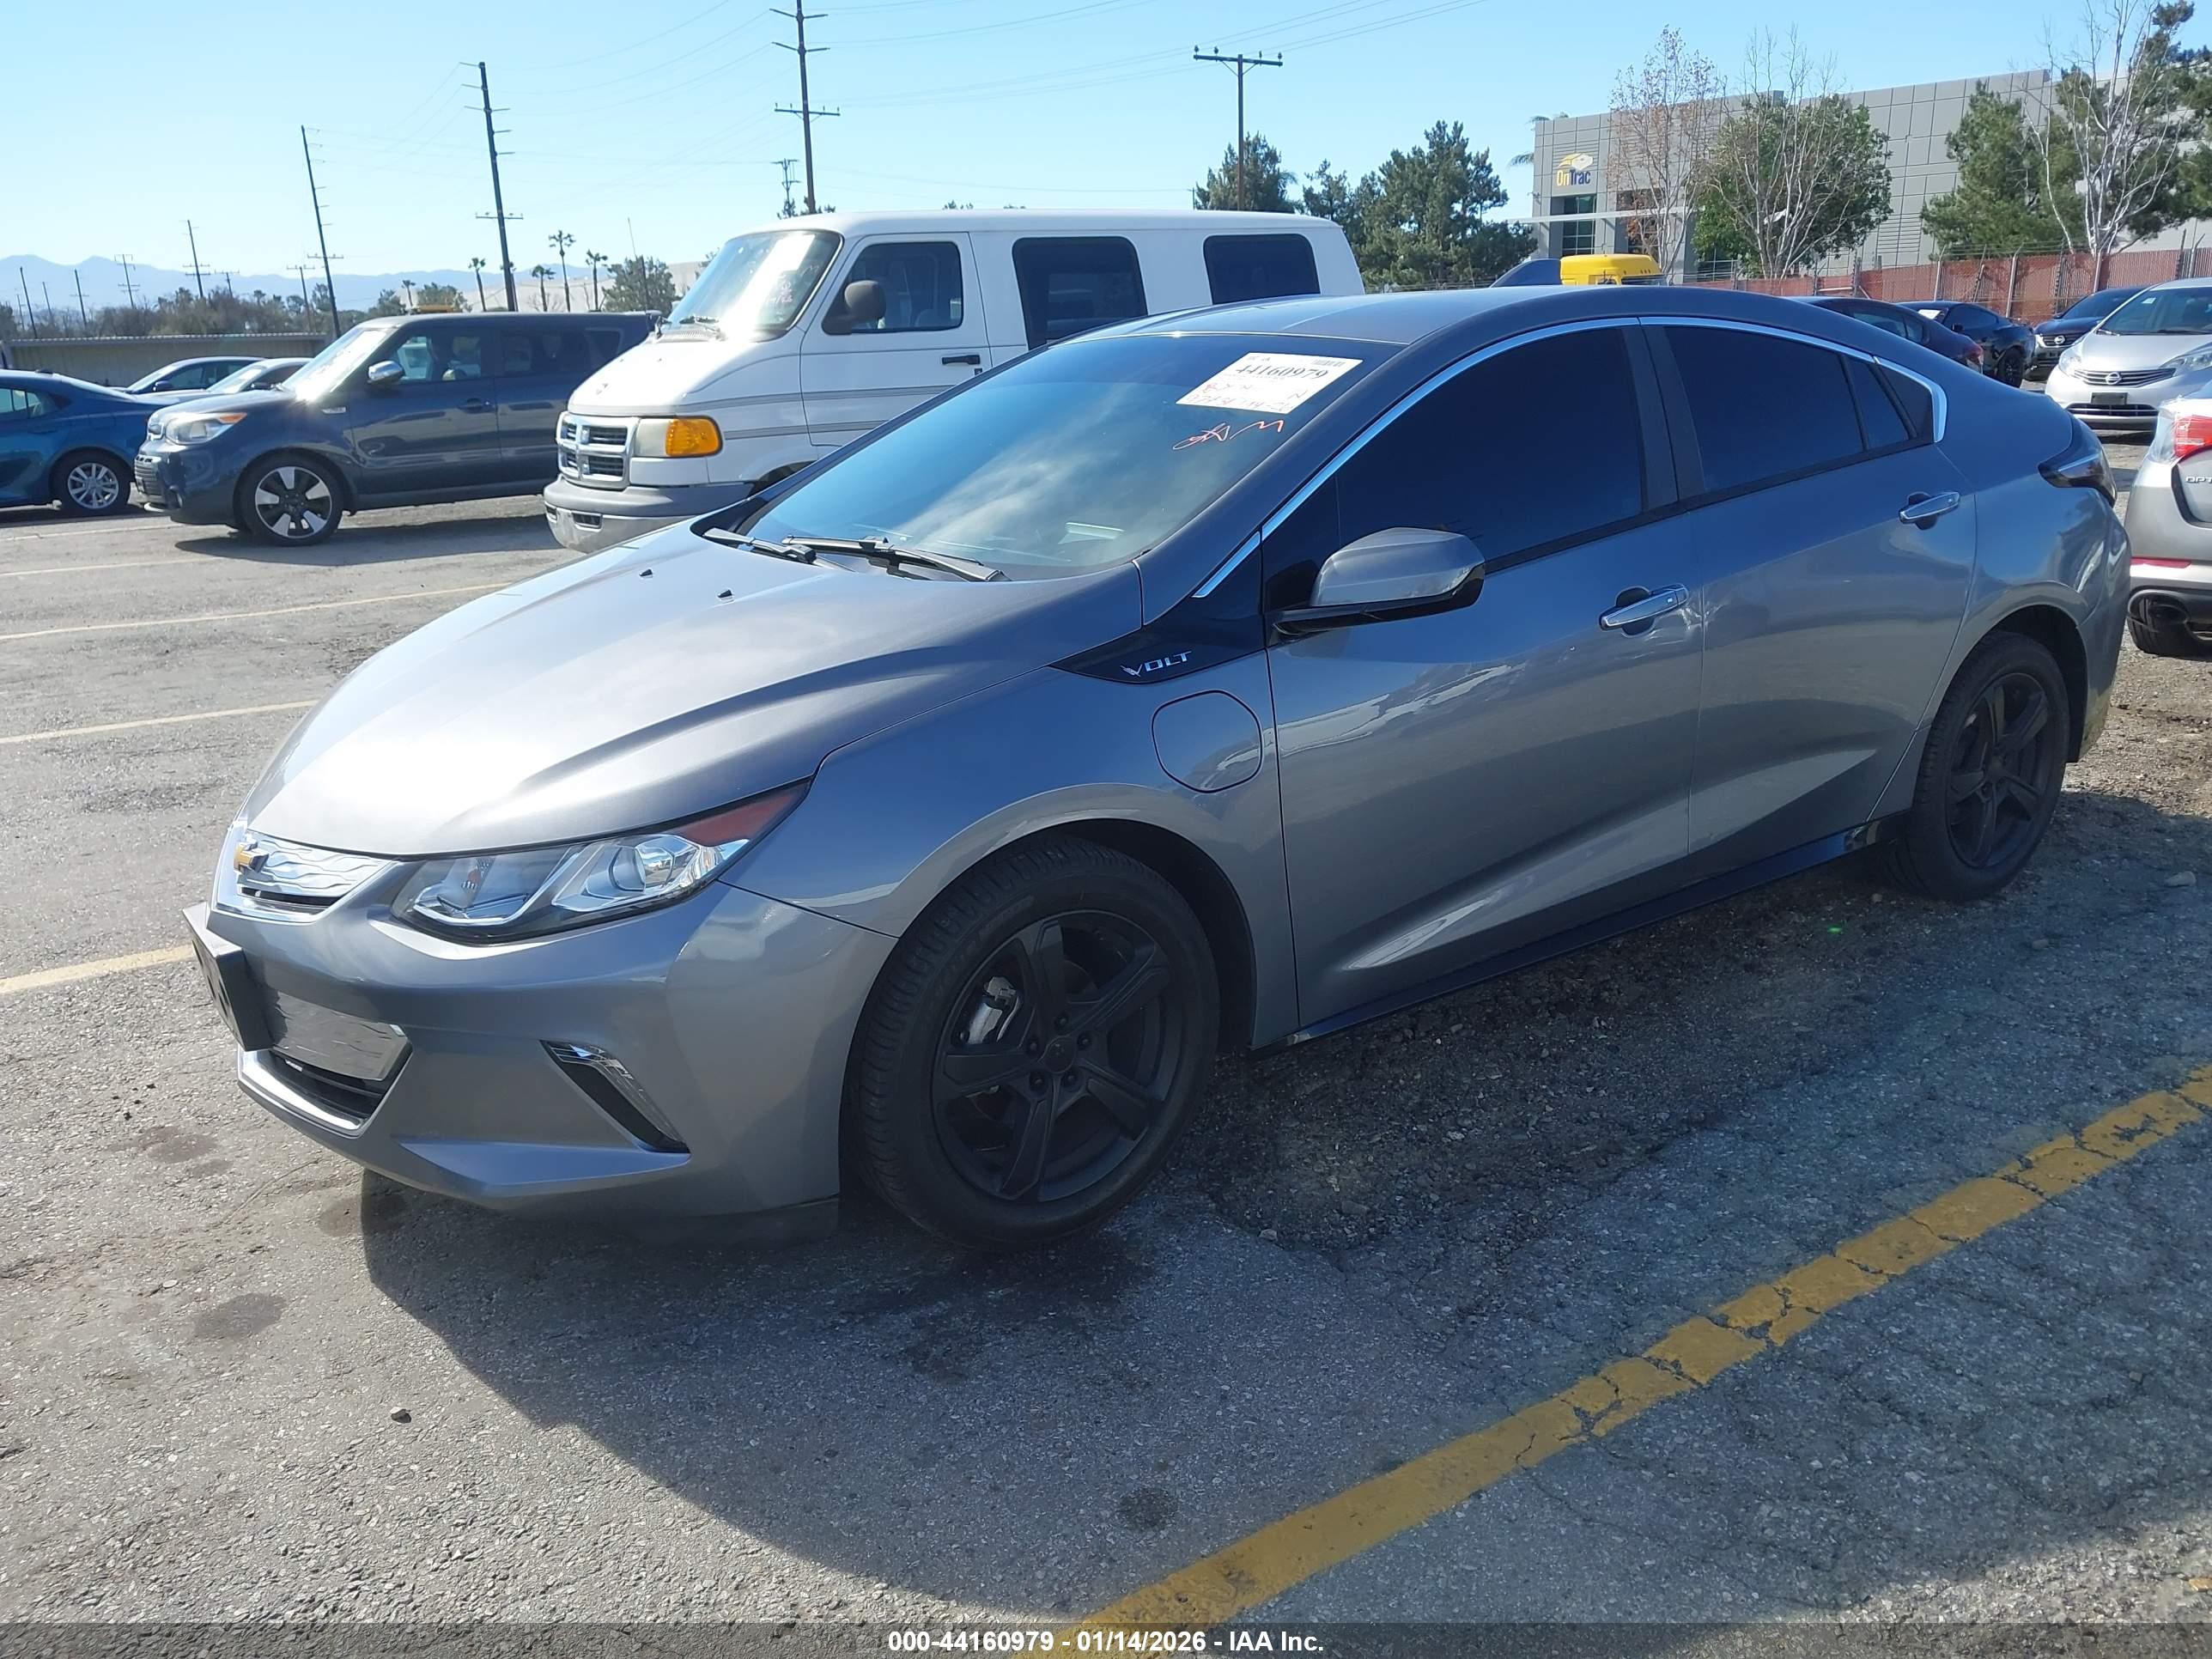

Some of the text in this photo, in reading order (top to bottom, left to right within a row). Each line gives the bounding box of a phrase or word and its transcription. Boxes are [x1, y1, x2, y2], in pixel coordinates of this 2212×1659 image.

[1557, 169, 1591, 186] OnTrac
[1236, 365, 1329, 380] 44160979
[1120, 651, 1192, 677] VOLT
